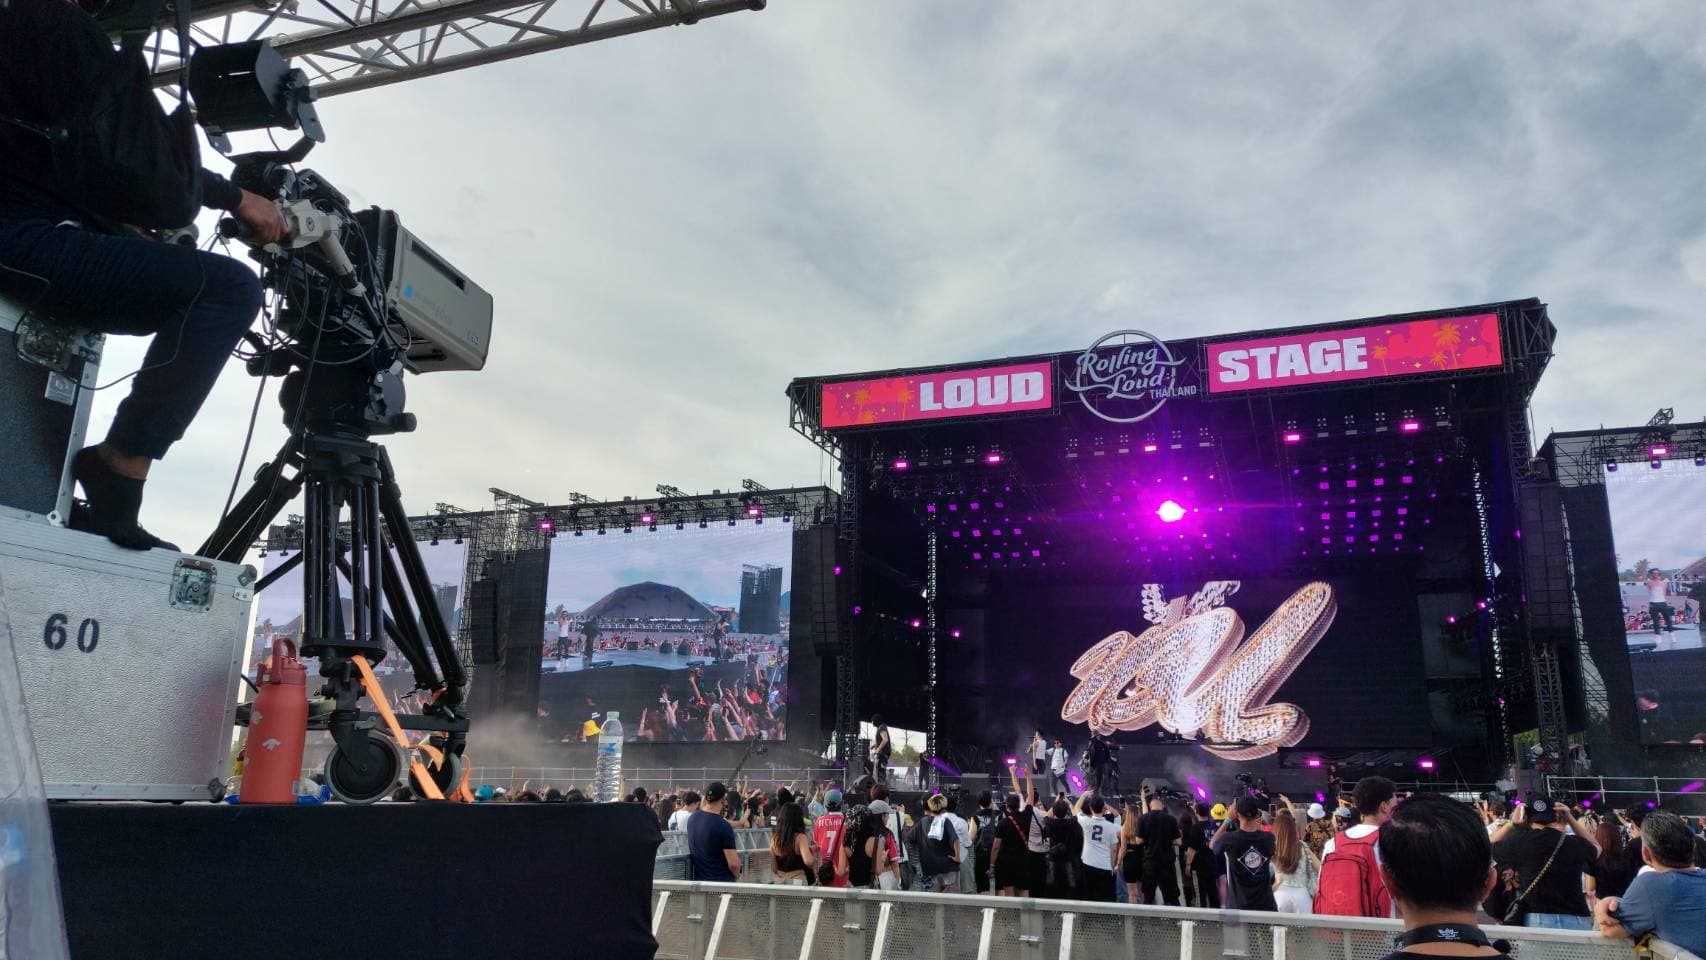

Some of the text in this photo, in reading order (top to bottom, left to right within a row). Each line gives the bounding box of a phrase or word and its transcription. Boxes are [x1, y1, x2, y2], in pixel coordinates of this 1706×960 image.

[1076, 346, 1187, 382] Rolling
[1218, 336, 1369, 383] STAGE
[919, 371, 1044, 412] LOUD
[1150, 385, 1197, 399] THAILAND
[44, 613, 99, 653] 60
[826, 830, 837, 857] 7
[1091, 825, 1103, 841] 2
